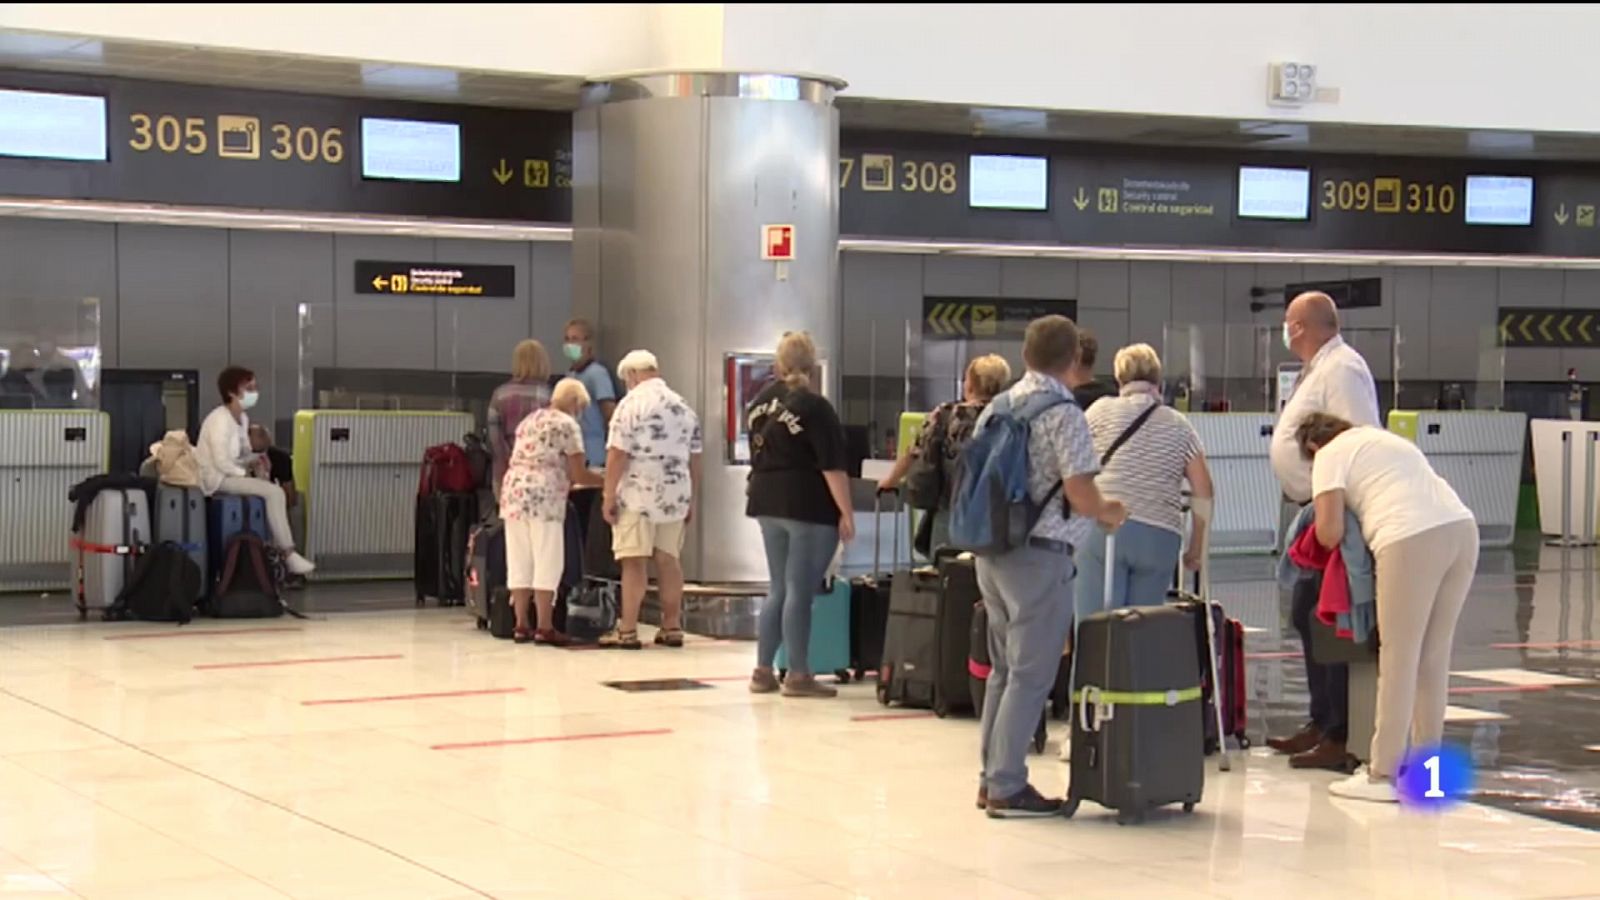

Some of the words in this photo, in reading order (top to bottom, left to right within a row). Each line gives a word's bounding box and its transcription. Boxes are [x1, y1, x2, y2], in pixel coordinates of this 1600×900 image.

[129, 114, 208, 154] 305
[270, 124, 344, 163] 306
[901, 161, 957, 194] 308
[1122, 201, 1156, 213] Control
[1320, 180, 1370, 211] 309
[1406, 183, 1455, 213] 310
